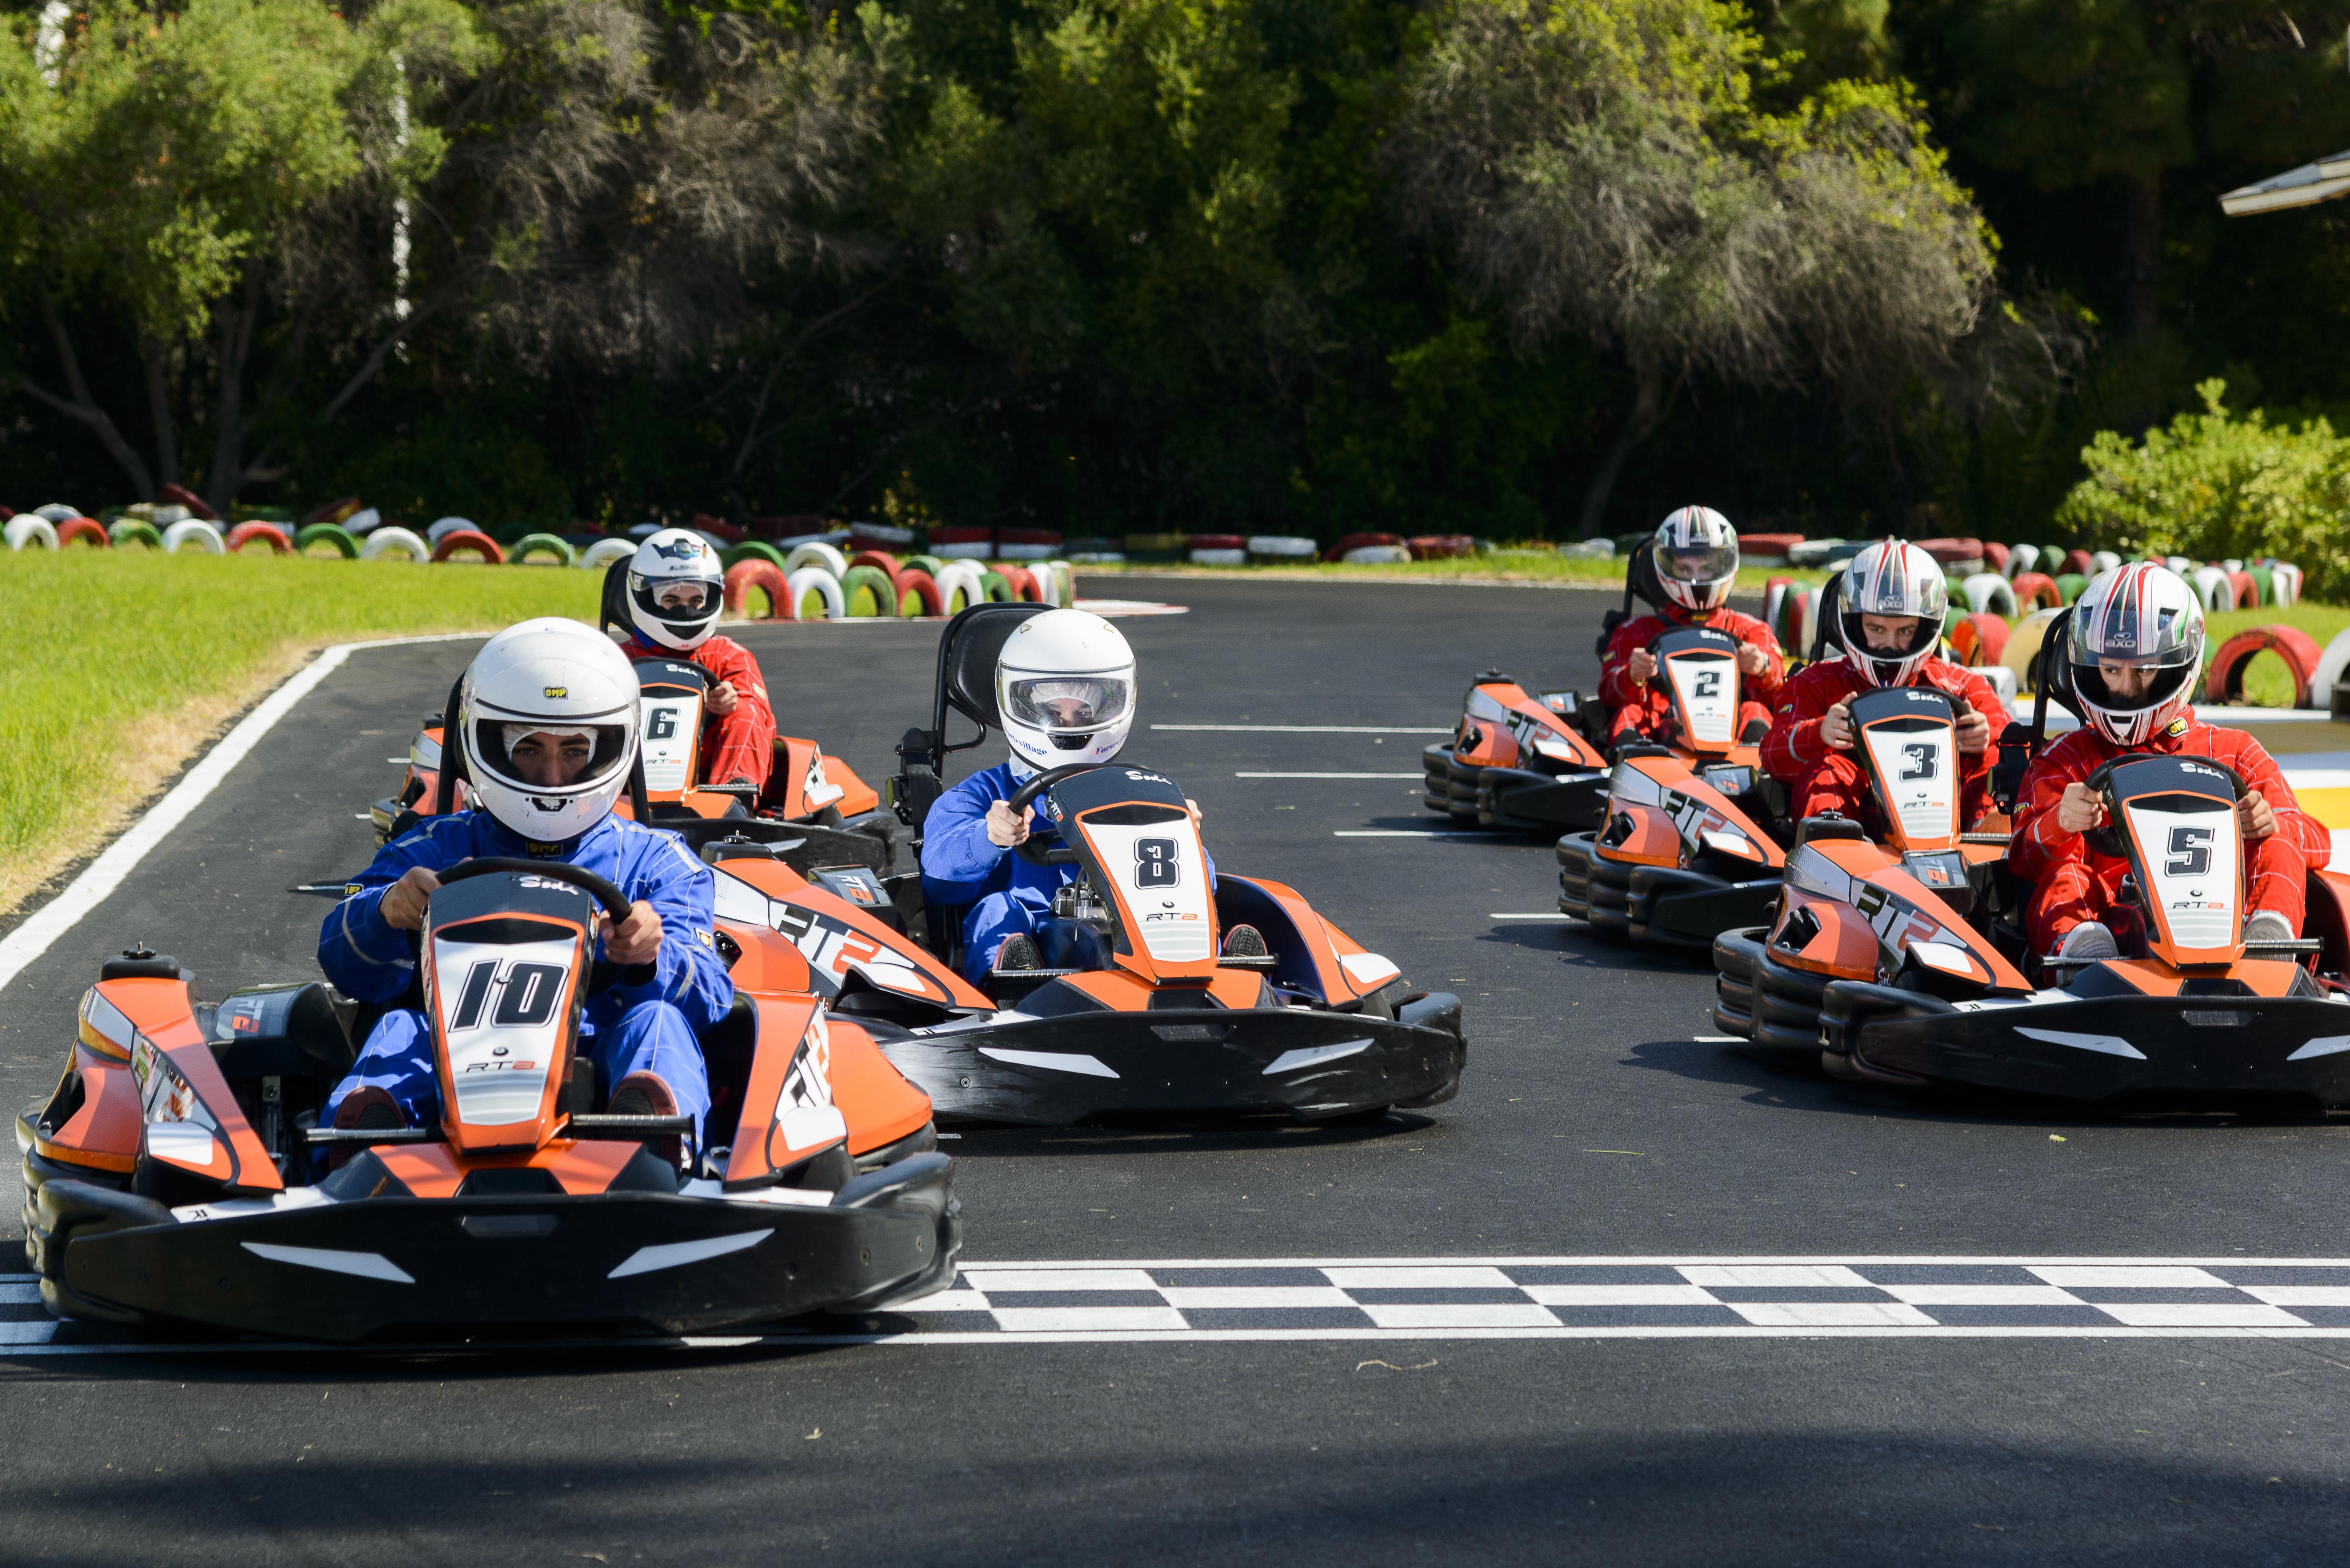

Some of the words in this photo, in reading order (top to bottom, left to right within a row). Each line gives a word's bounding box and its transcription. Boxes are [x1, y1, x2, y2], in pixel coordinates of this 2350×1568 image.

[544, 688, 567, 697] OMP
[1692, 670, 1723, 699] 2
[644, 707, 680, 742] 6
[1900, 742, 1939, 783] 3
[2180, 763, 2224, 780] Sodi
[1125, 771, 1172, 785] Sodi
[1134, 837, 1179, 889] 8
[2165, 826, 2215, 877] 5
[519, 875, 579, 895] Sodi
[448, 958, 569, 1033] 10
[466, 1060, 535, 1073] RT8
